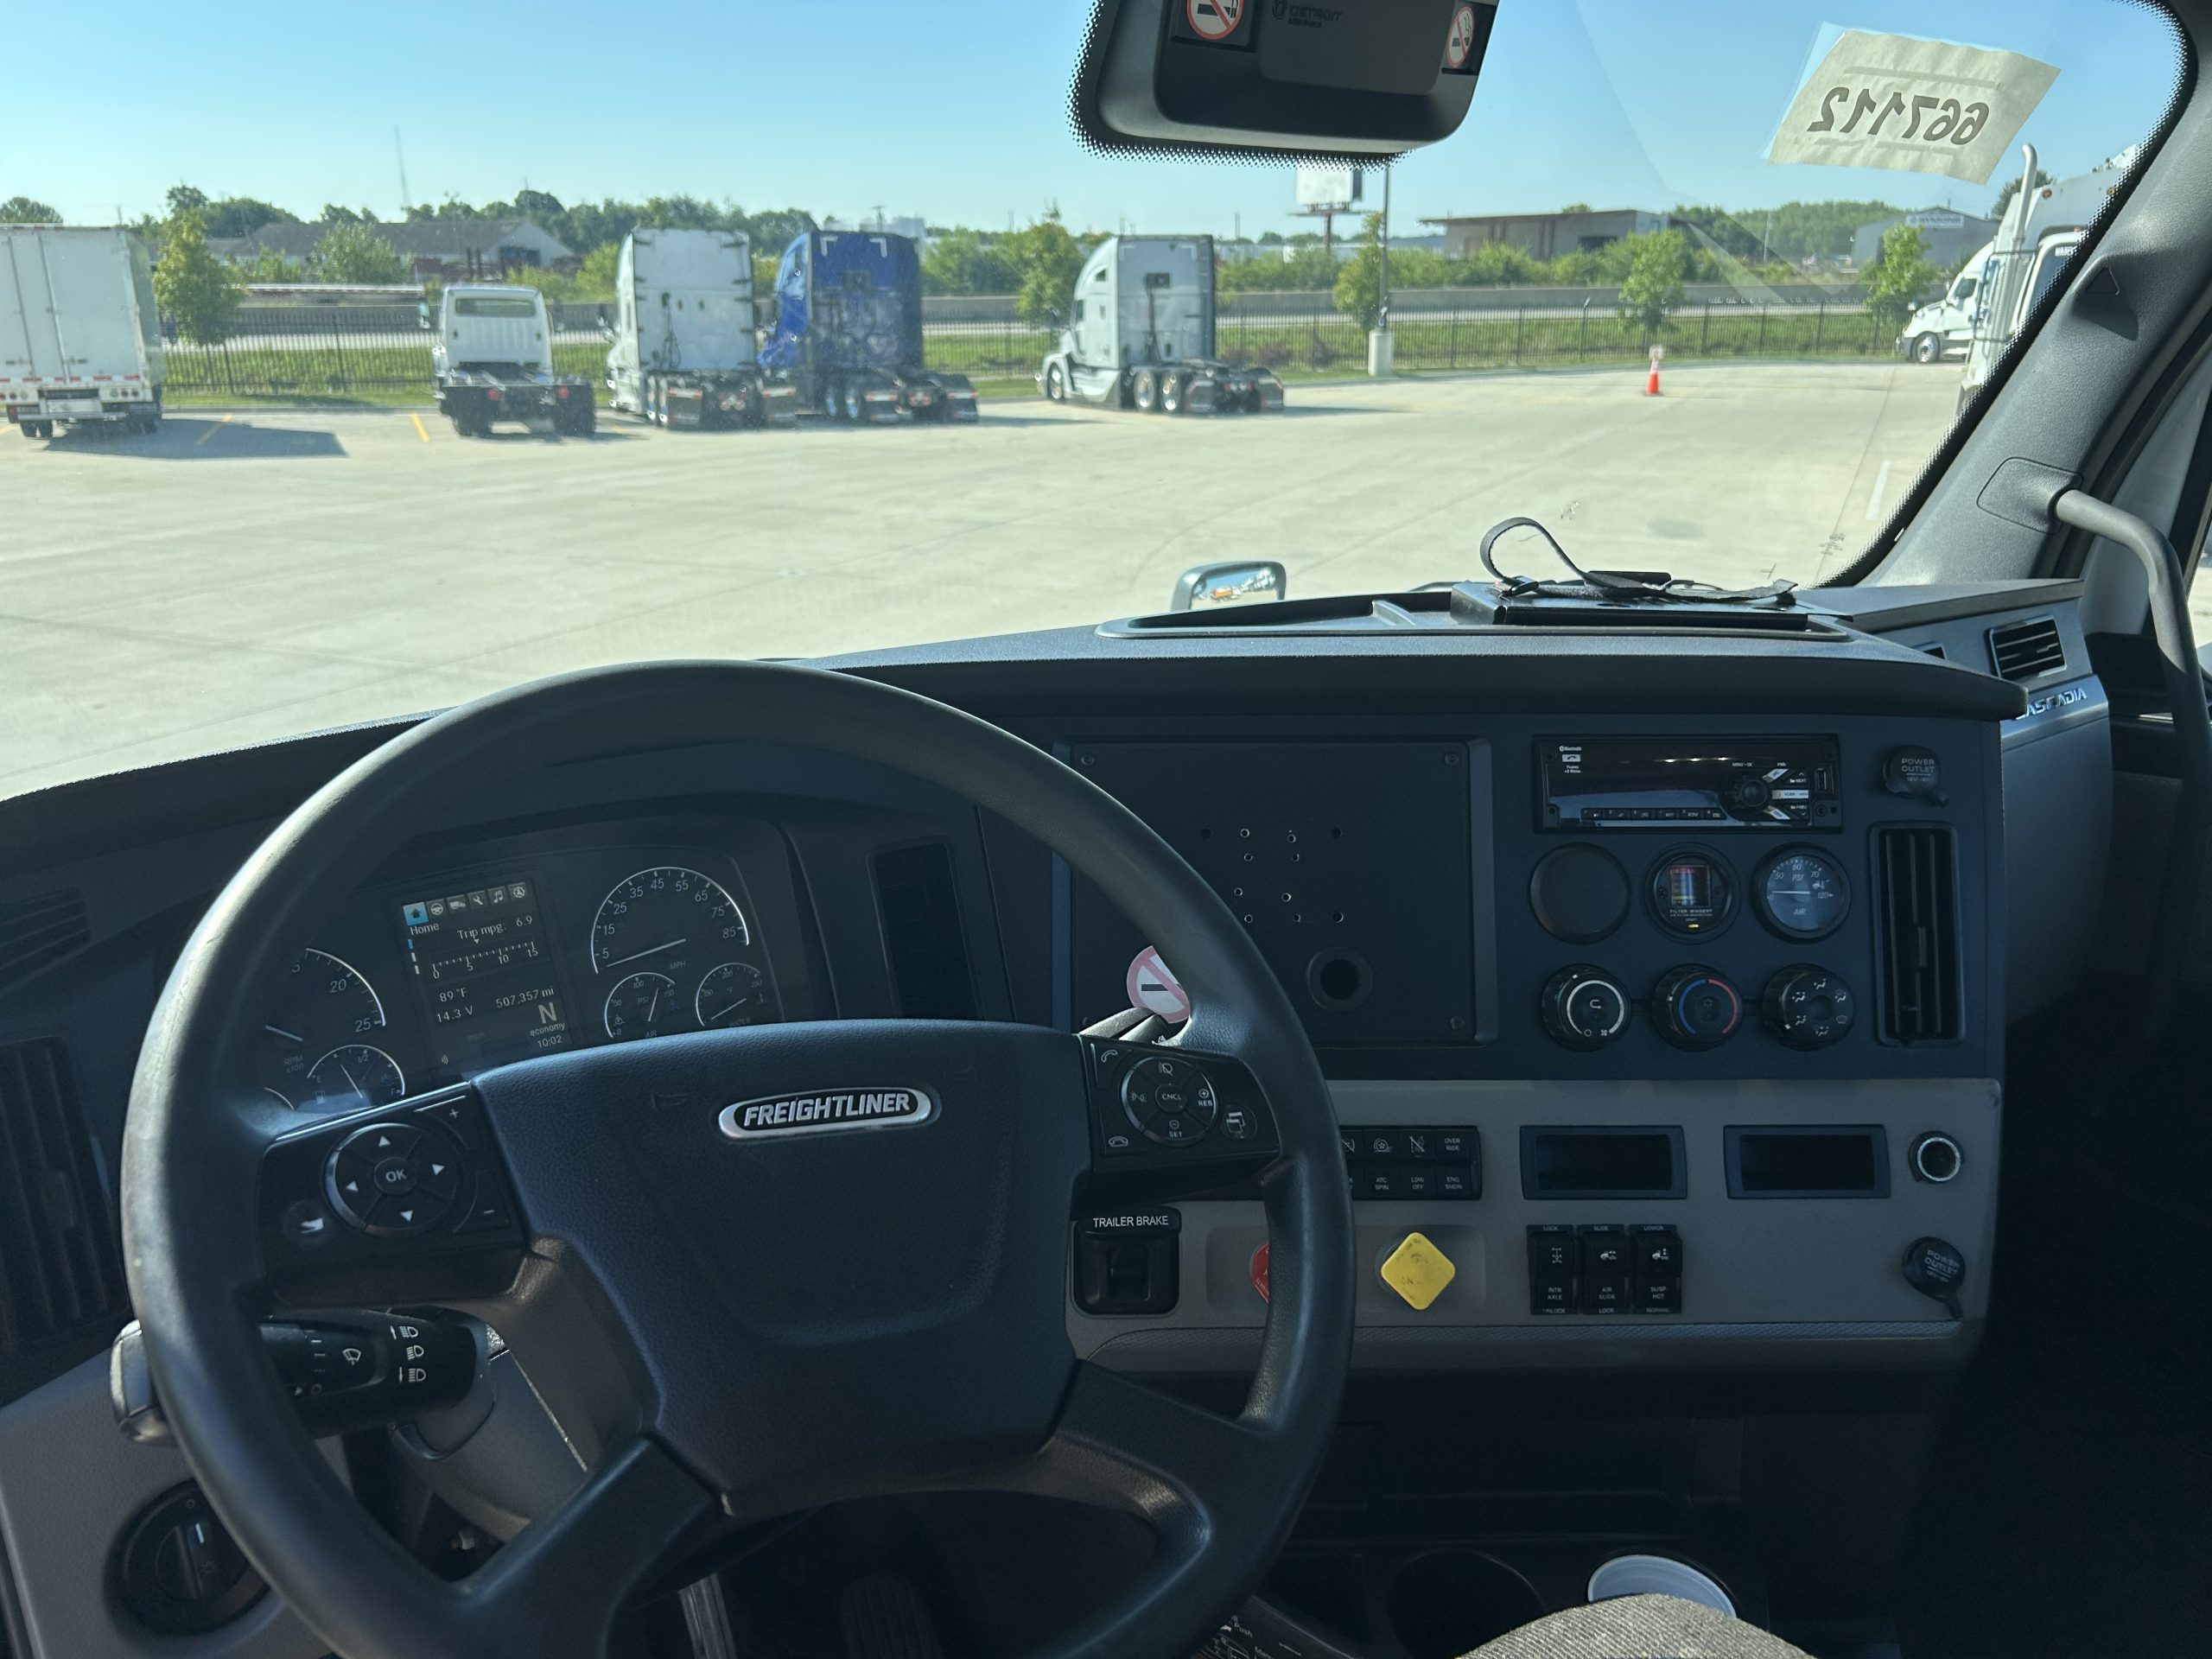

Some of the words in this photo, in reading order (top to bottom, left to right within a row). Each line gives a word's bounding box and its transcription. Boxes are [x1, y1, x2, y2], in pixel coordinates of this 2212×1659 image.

[2020, 688, 2088, 718] ASCADIA
[650, 878, 664, 890] 45
[675, 880, 690, 892] 55
[629, 887, 644, 899] 35
[695, 889, 709, 902] 65
[613, 902, 627, 915] 25
[711, 906, 725, 919] 75
[410, 923, 441, 937] Home
[457, 928, 479, 940] Trip
[516, 915, 533, 927] 6.9
[604, 927, 615, 937] 15
[721, 926, 736, 940] 85
[602, 948, 609, 959] 5
[467, 963, 474, 972] 5
[498, 956, 510, 965] 10
[670, 961, 686, 970] MPH
[330, 979, 346, 993] 20
[542, 985, 555, 997] mi
[439, 990, 454, 1003] 89
[436, 1010, 461, 1023] 14.3
[465, 1005, 474, 1016] V
[538, 1001, 557, 1024] N
[354, 1018, 372, 1033] 25
[530, 1022, 565, 1038] economy
[537, 1035, 563, 1050] 10:02
[283, 1055, 303, 1065] RPM
[744, 1093, 910, 1126] FREIGHTLINER
[385, 1168, 407, 1183] OK
[1093, 1217, 1135, 1228] TRAILER
[1136, 1215, 1169, 1226] BRAKE
